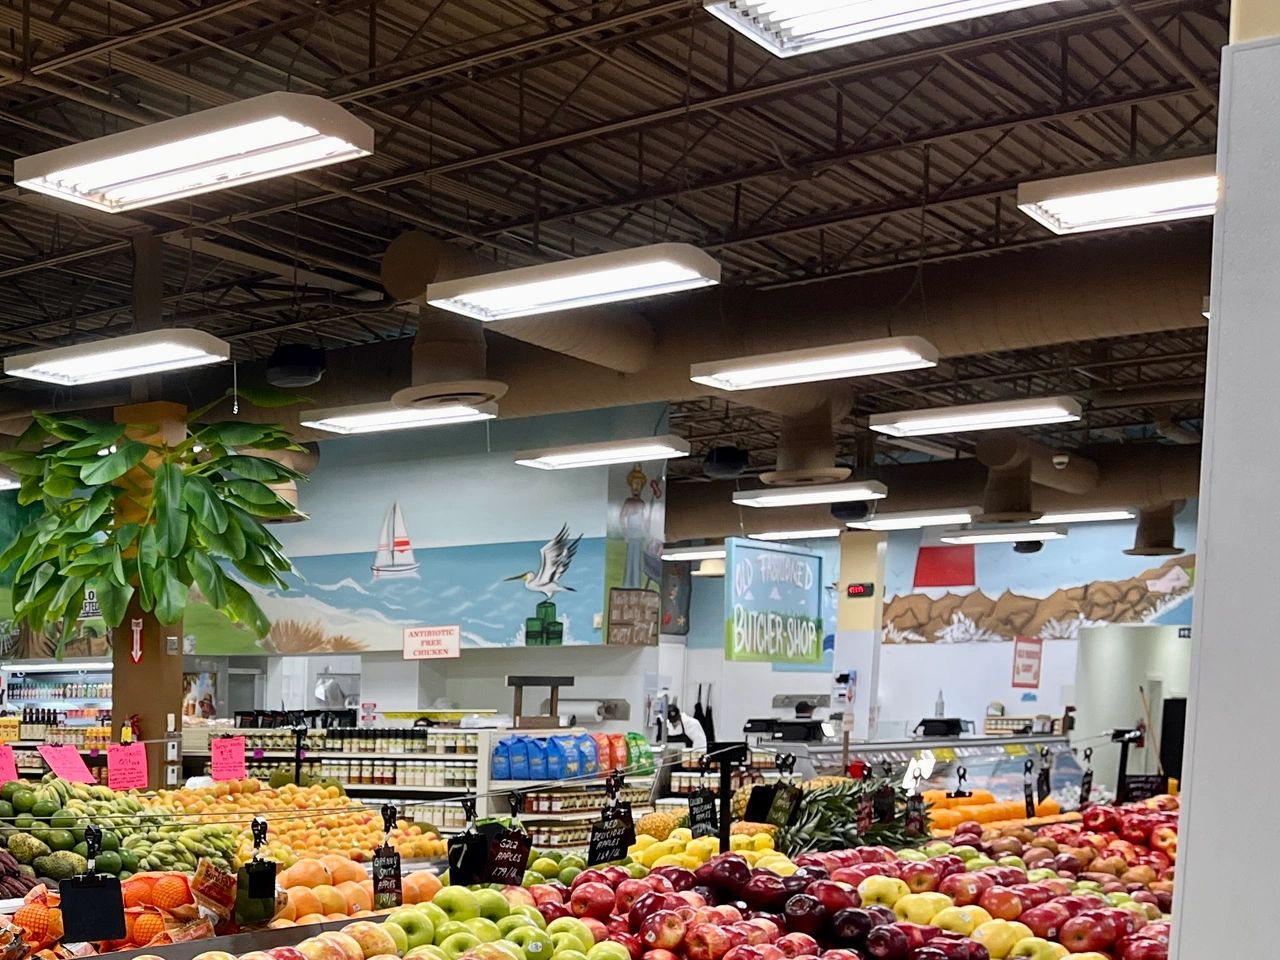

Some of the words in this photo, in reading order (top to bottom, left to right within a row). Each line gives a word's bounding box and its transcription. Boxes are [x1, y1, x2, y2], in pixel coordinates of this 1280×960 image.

[735, 557, 753, 597] OLD
[757, 554, 813, 591] FASHIONED
[409, 629, 454, 638] ANTIBIOTIC
[604, 821, 618, 829] RED
[593, 828, 625, 841] DELICIOUS
[597, 838, 619, 849] APPLES
[495, 852, 522, 862] APPLES
